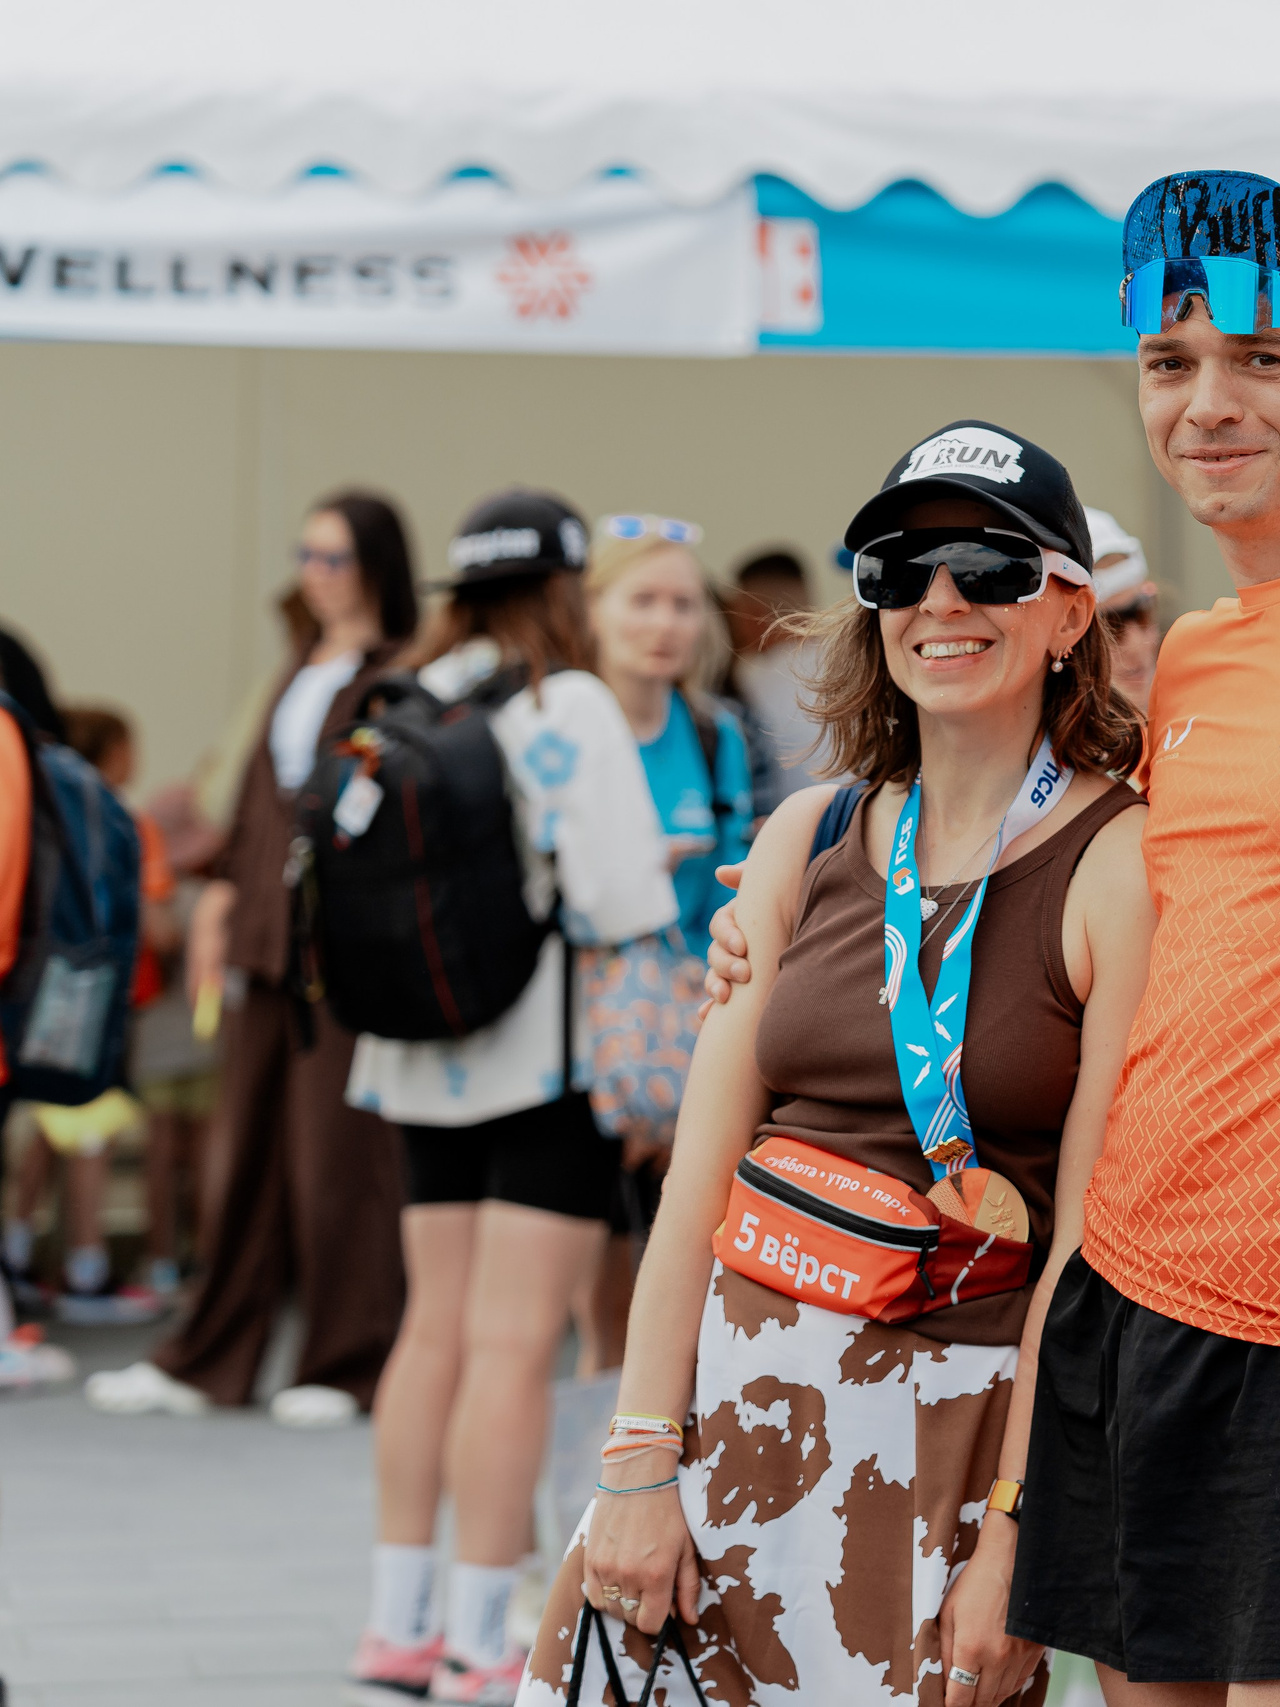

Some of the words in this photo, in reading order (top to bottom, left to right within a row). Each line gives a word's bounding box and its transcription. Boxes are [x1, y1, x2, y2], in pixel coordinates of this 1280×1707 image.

[933, 446, 1011, 469] RUN
[1030, 761, 1062, 809] ПСБ
[895, 817, 913, 865] ПСБ
[764, 1155, 818, 1179] суббота
[825, 1171, 861, 1192] утро
[872, 1188, 911, 1217] парк
[733, 1211, 760, 1253] 5
[758, 1232, 861, 1300] вёрст
